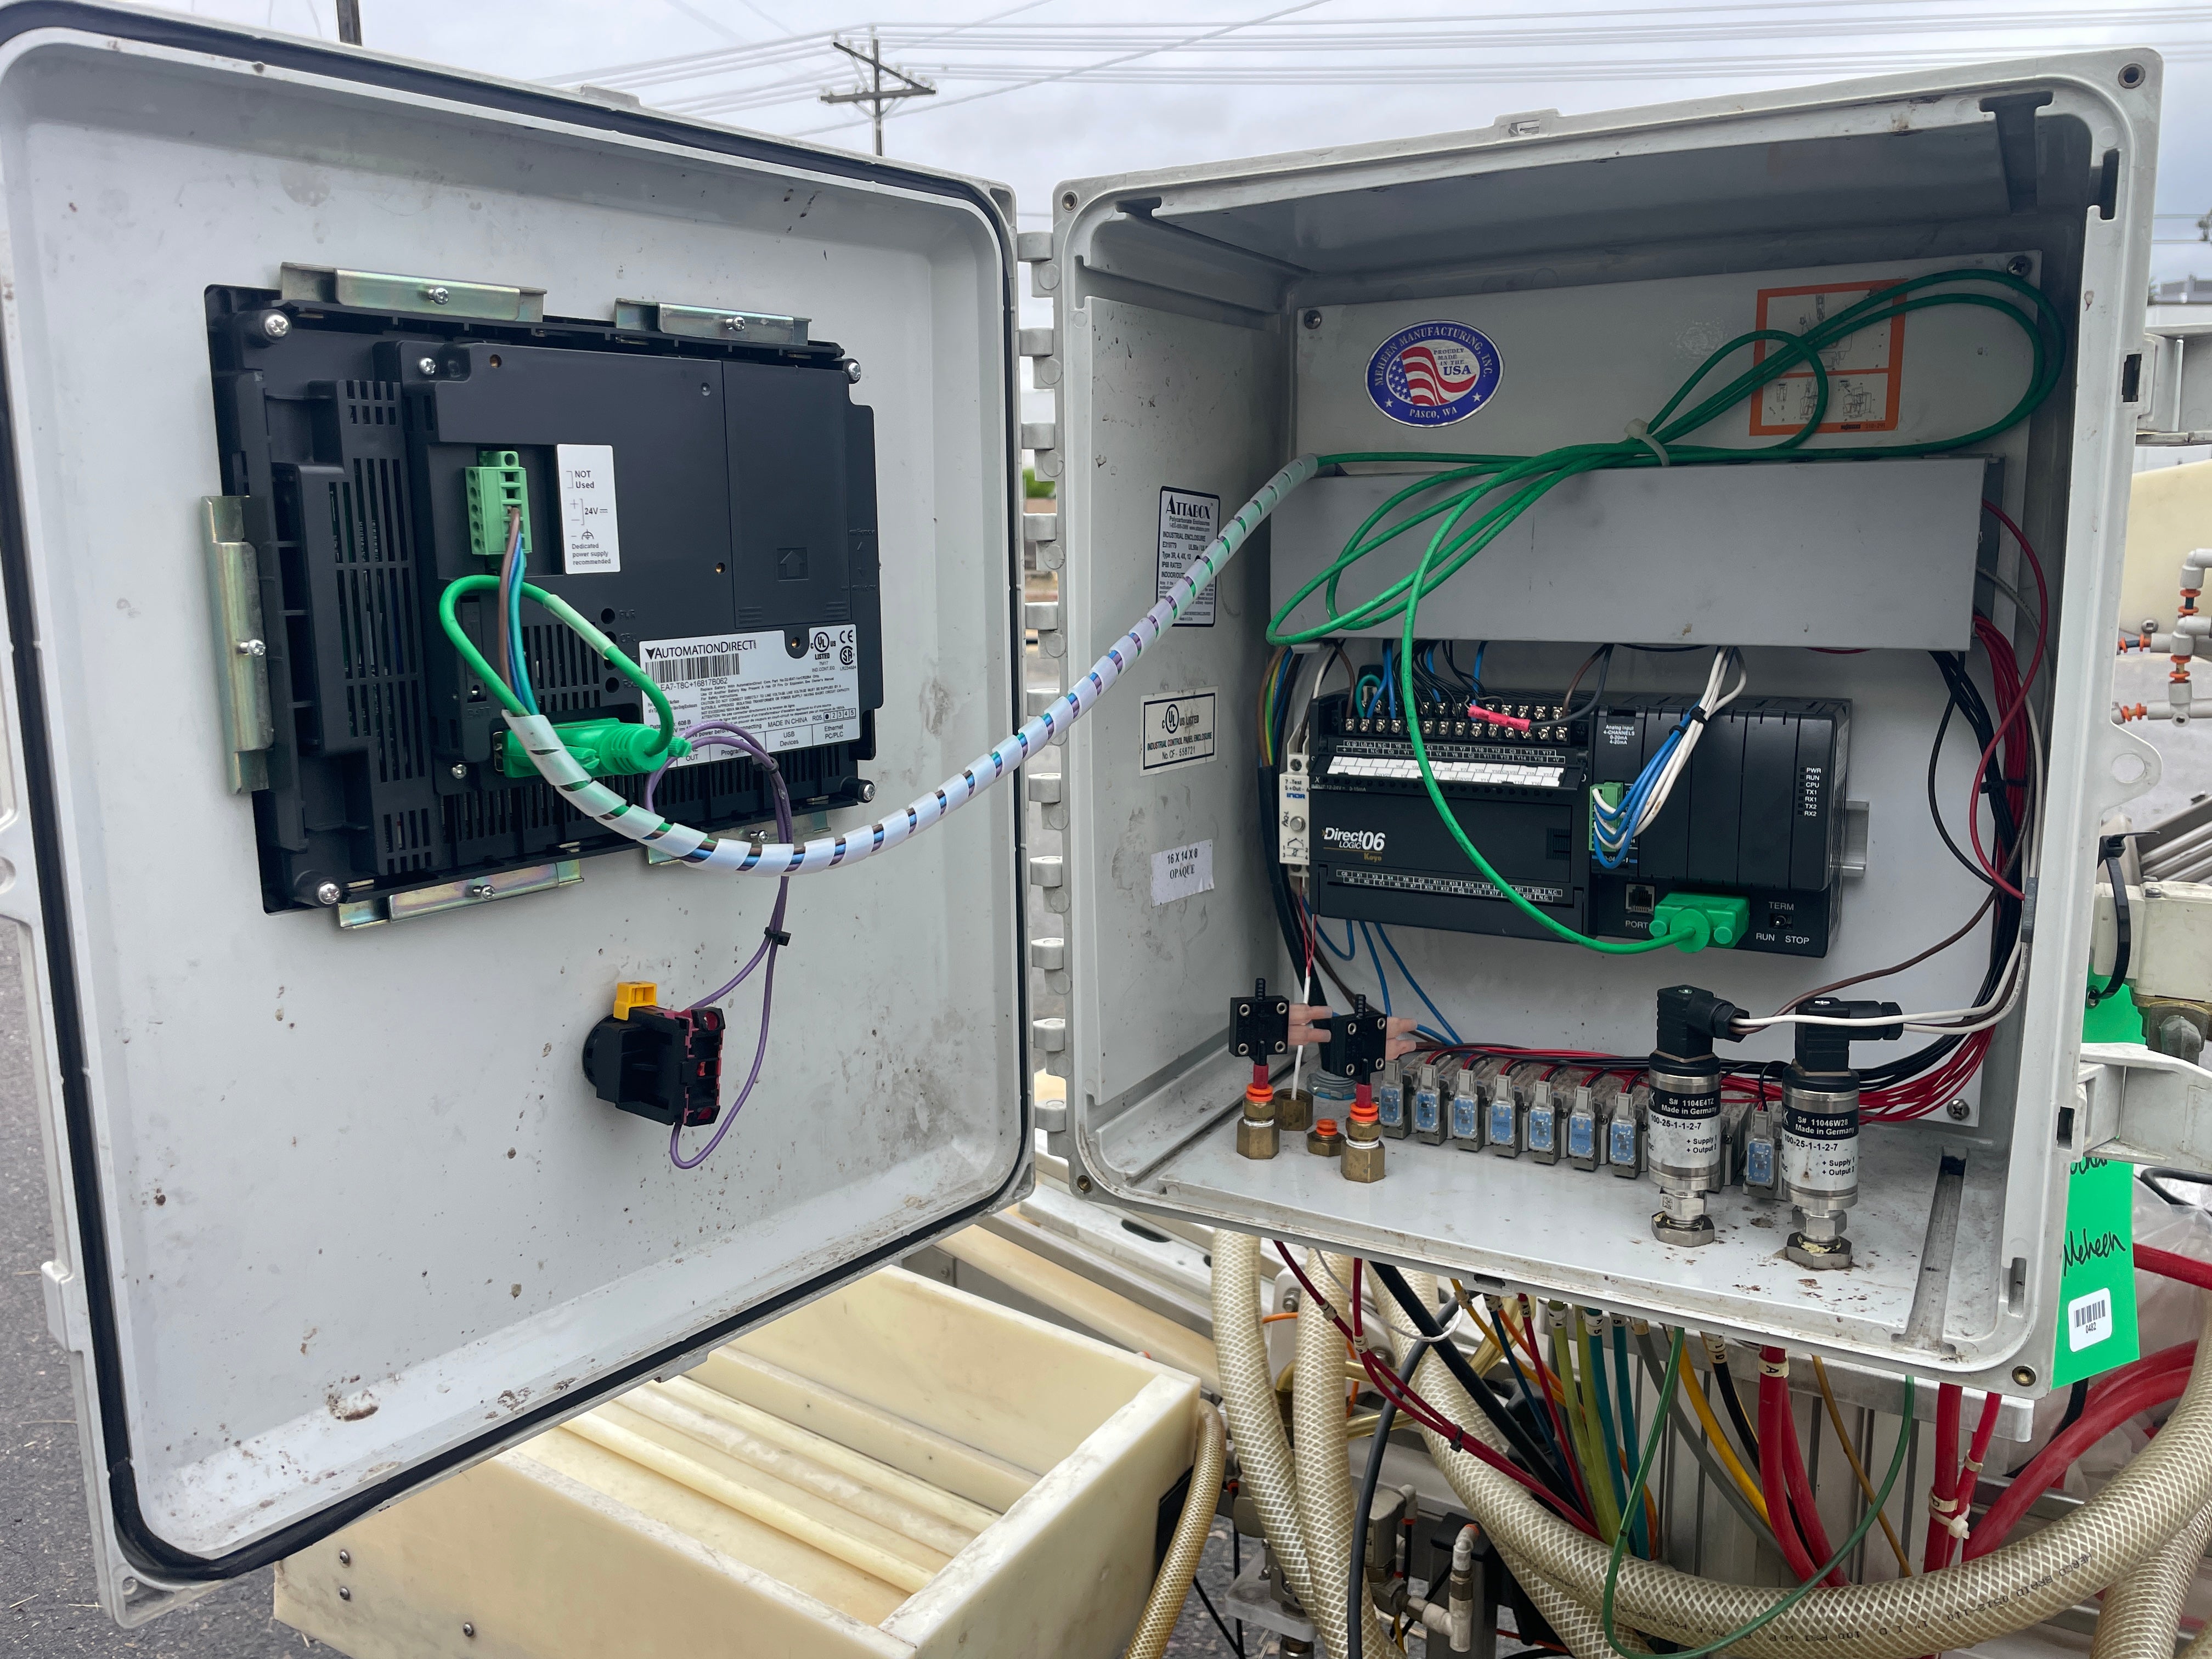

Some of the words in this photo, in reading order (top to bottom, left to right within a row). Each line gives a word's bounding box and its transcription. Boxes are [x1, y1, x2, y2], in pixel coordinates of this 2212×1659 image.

[1443, 365, 1472, 376] USA
[1409, 408, 1440, 419] PASCO,
[1442, 407, 1458, 417] WA
[1166, 494, 1210, 520] ATTABOX
[1163, 531, 1183, 540] INDUSTRIAL
[1184, 533, 1206, 542] ENCLOSURE
[661, 677, 728, 691] EA7-T8C+16817B062
[825, 731, 844, 740] PC/PLC
[1147, 740, 1167, 751] INDUSTRIAL
[1167, 737, 1183, 747] CONTROL
[1183, 735, 1194, 744] PANEL
[1194, 731, 1212, 743] ENCLOSURE
[1324, 827, 1364, 842] Direct
[1362, 831, 1385, 851] 06
[1339, 840, 1362, 849] LOGIC
[1167, 853, 1174, 865] 16
[1175, 852, 1180, 863] X
[1181, 850, 1188, 861] 14
[1364, 852, 1382, 862] Koyo
[1170, 864, 1195, 879] OPAQUE
[1768, 901, 1794, 911] TERM
[1625, 920, 1648, 929] PORT
[1756, 932, 1775, 941] RUN
[1785, 935, 1809, 944] STOP
[1661, 1104, 1680, 1114] Made
[1690, 1106, 1717, 1115] Germany
[1651, 1114, 1702, 1130] 100-25-1-1-2-7
[1797, 1116, 1807, 1124] S#
[1811, 1119, 1848, 1127] 11046W28
[1795, 1124, 1814, 1134] Made
[1826, 1126, 1854, 1136] Germany
[1693, 1136, 1714, 1145] Supply
[1784, 1133, 1838, 1152] 100-25-1-1-2-7
[1693, 1145, 1713, 1154] Output
[1829, 1158, 1851, 1167] Supply
[1829, 1167, 1851, 1176] Output
[2063, 1228, 2126, 1276] Meheen
[2085, 1322, 2097, 1334] 0482
[2058, 1552, 2093, 1577] HERCO
[2016, 1576, 2053, 1597] BRAID
[1946, 1595, 2009, 1622] 0512-110
[1837, 1630, 1860, 1640] 100
